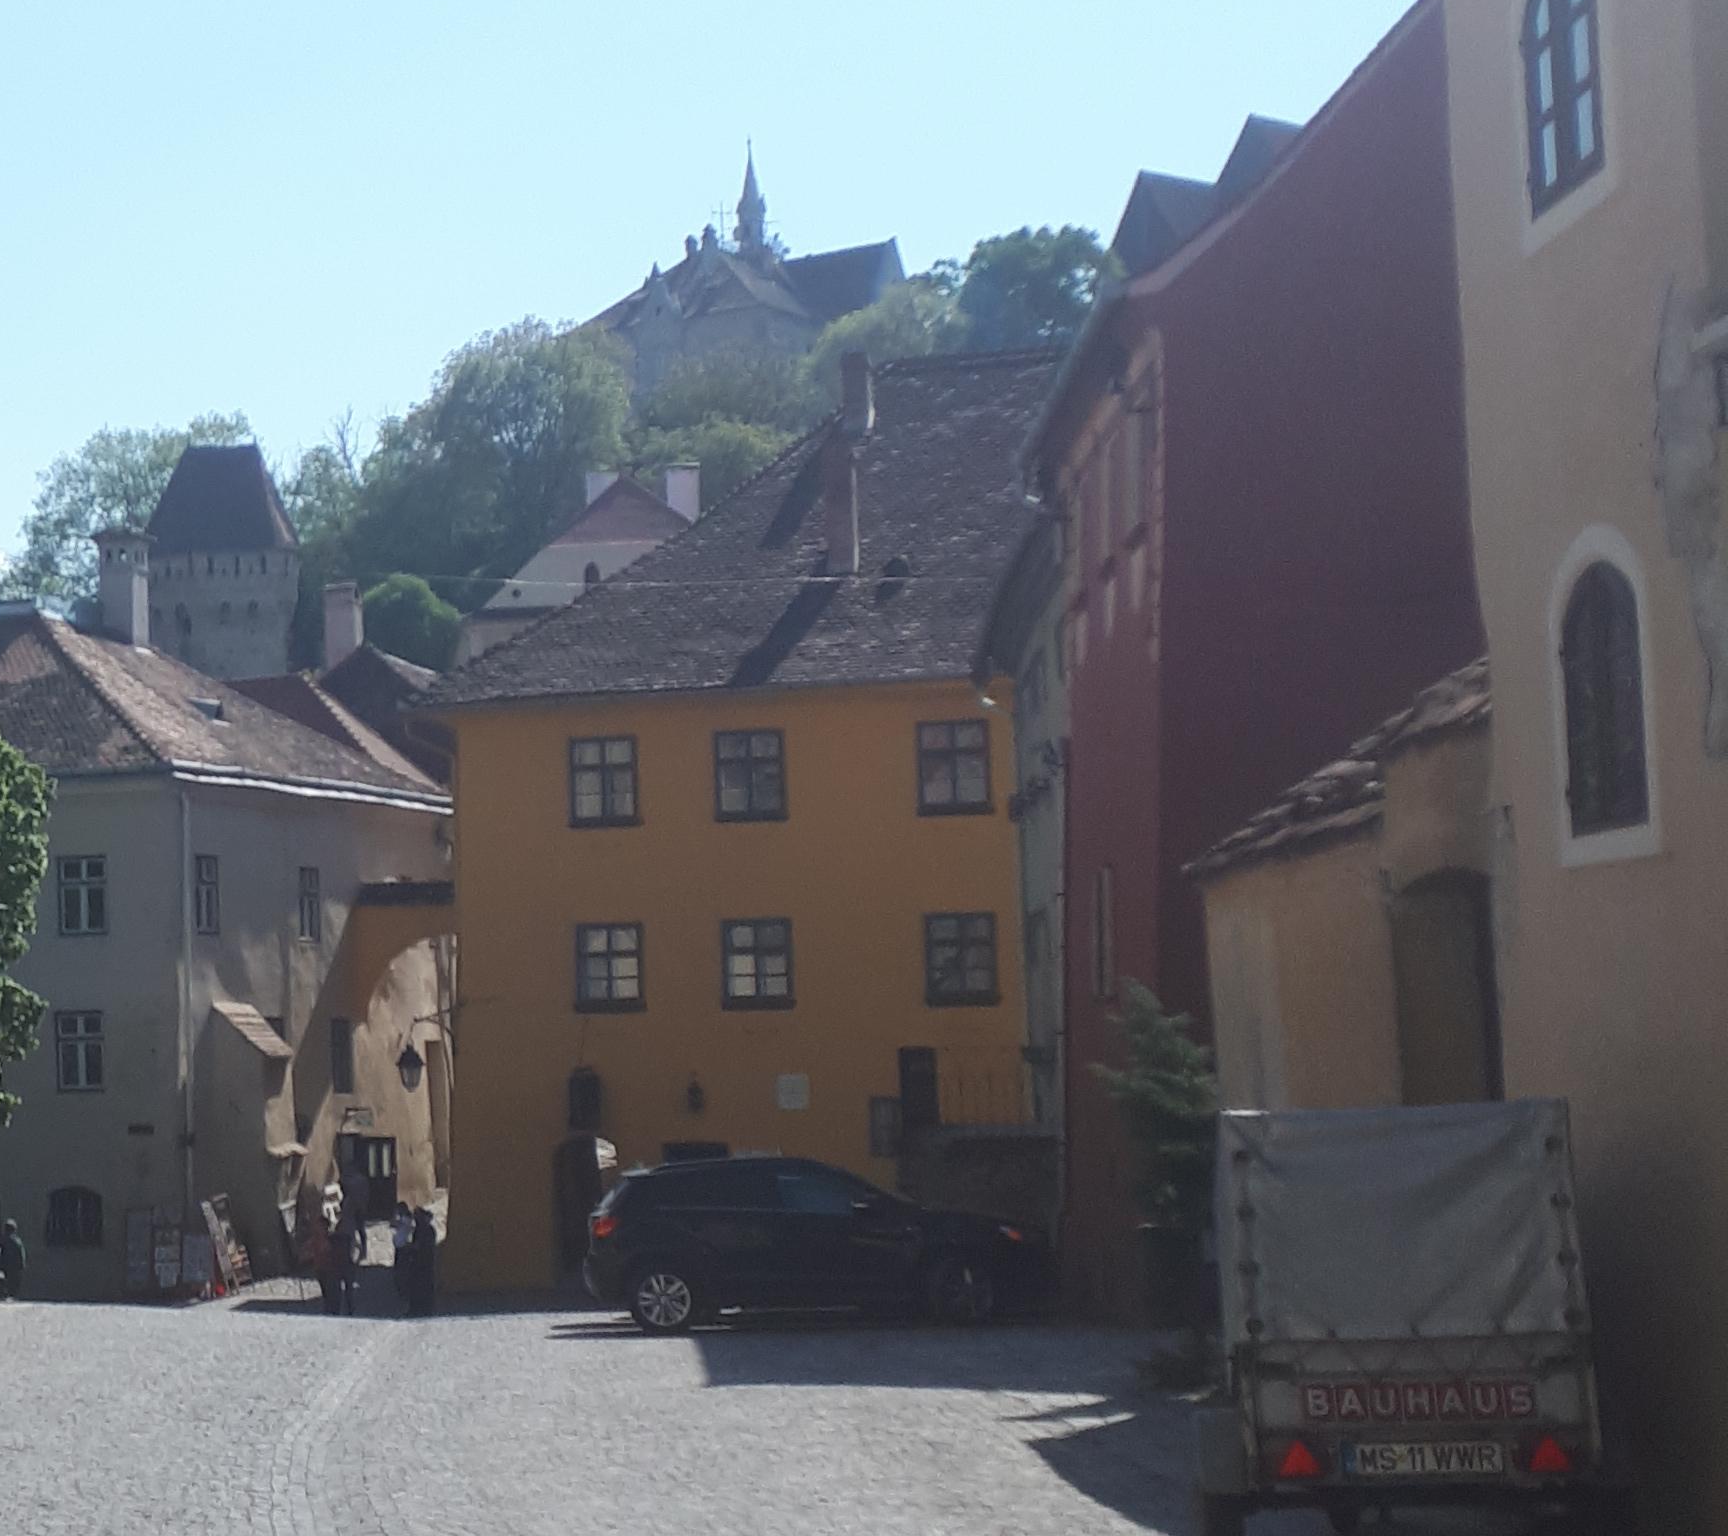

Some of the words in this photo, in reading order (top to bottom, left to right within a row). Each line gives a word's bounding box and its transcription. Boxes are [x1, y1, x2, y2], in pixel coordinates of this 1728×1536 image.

[1307, 1386, 1534, 1416] BAUHAUS
[1360, 1445, 1398, 1471] MS
[1406, 1444, 1426, 1470] 11
[1431, 1443, 1498, 1470] WWR
